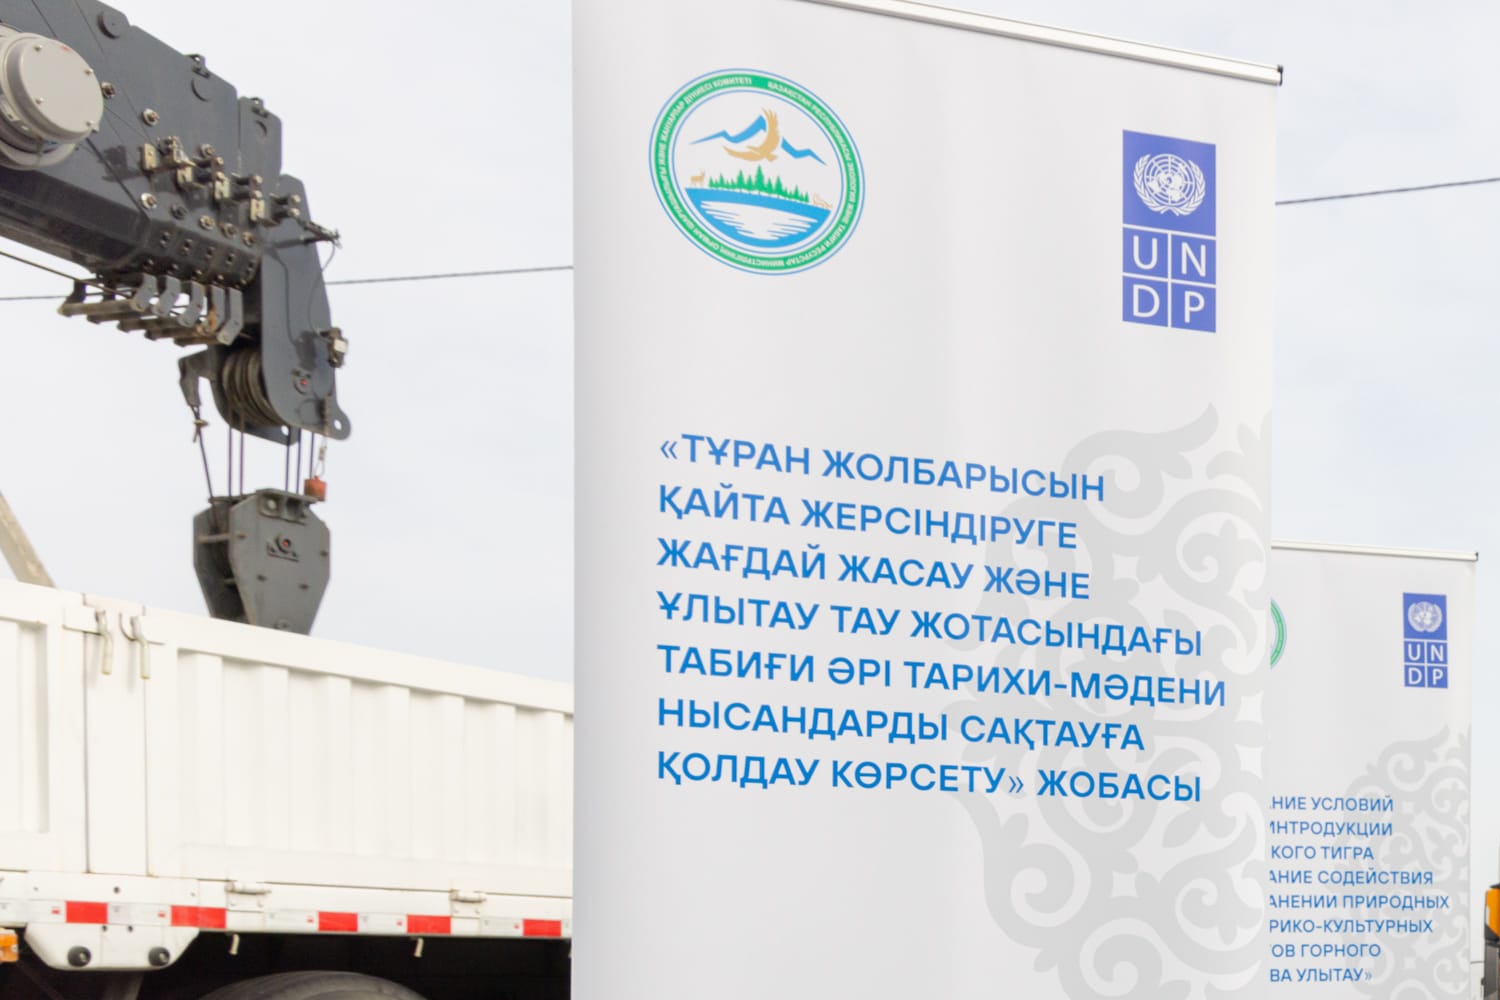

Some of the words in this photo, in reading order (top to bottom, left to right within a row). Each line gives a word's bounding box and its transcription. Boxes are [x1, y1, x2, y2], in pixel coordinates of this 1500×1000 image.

[661, 433, 810, 475] «ТҰРАН
[823, 449, 1104, 502] ЖОЛБАРЫСЫН
[660, 483, 790, 525] ҚАЙТА
[801, 499, 1077, 550] ЖЕРСІНДІРУГЕ
[657, 537, 826, 581] ЖАҒДАЙ
[839, 554, 973, 589] ЖАСАУ
[984, 565, 1089, 600] ЖӘНЕ
[657, 591, 819, 630] ҰЛЫТАУ
[830, 605, 900, 636] ТАУ
[911, 610, 1201, 656] ЖОТАСЫНДАҒЫ
[656, 644, 814, 683] ТАБИҒИ
[827, 657, 891, 687] ӘРІ
[903, 661, 1225, 708] ТАРИХИ-МӘДЕНИ
[658, 697, 947, 745] НЫСАНДАРДЫ
[960, 715, 1145, 751] САҚТАУҒА
[658, 751, 820, 790] ҚОЛДАУ
[832, 759, 1024, 794] КӨРСЕТУ»
[1037, 769, 1201, 802] ЖОБАСЫ
[1270, 796, 1305, 810] НИЕ
[1312, 795, 1394, 812] УСЛОВИЙ
[1271, 845, 1316, 859] КОГО
[1321, 845, 1374, 860] ТИГРА
[1318, 868, 1433, 886] СОДЕЙСТВИЯ
[1342, 895, 1448, 911] ПРИРОДНЫХ
[1269, 918, 1432, 933] РИКО-КУЛЬТУРНЫХ
[1270, 944, 1296, 958] ОВ
[1301, 943, 1382, 958] ГОРНОГО
[1269, 968, 1292, 983] ВА
[1297, 967, 1370, 982] УЛЫТАУ»
